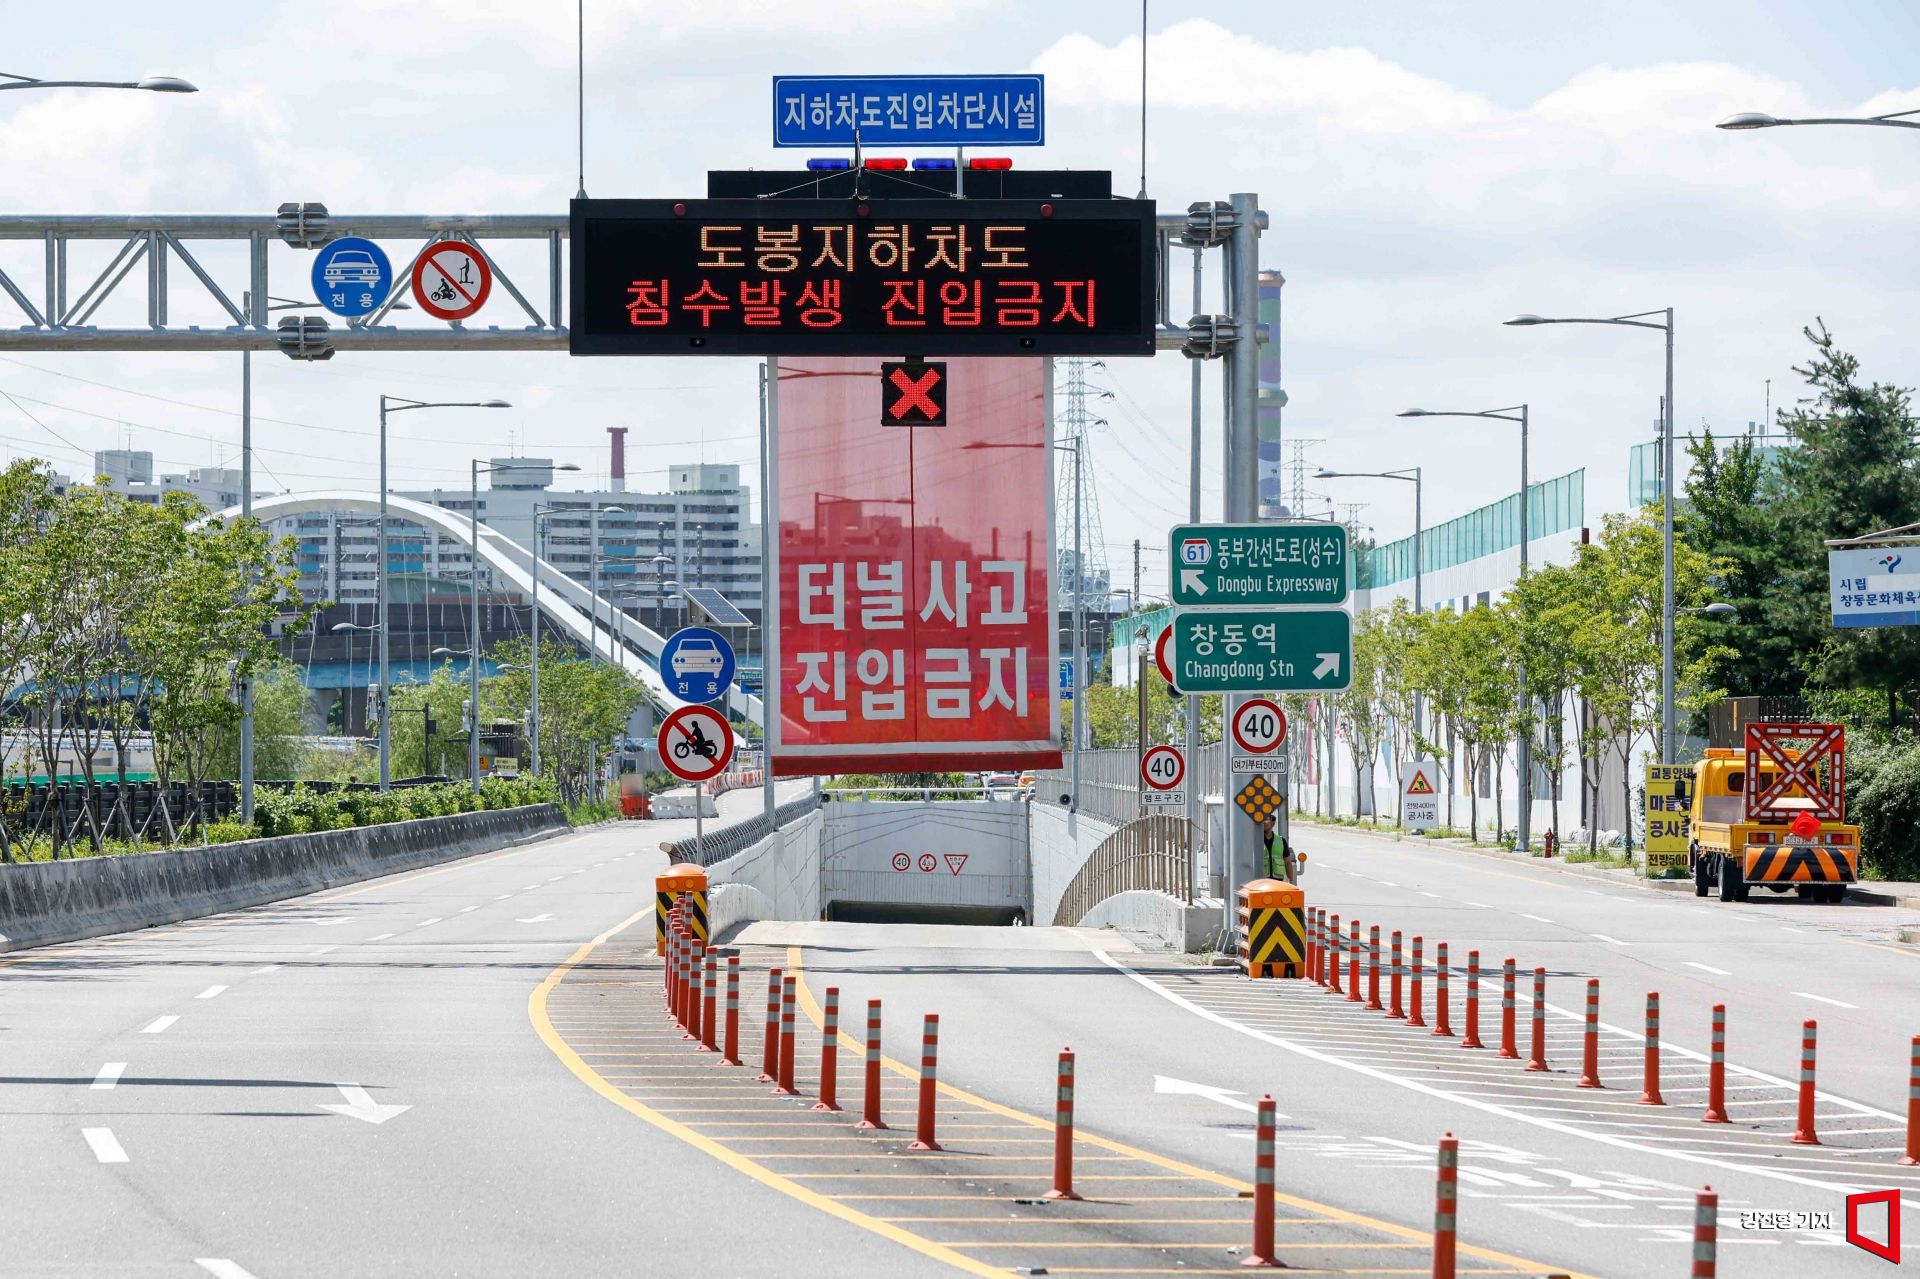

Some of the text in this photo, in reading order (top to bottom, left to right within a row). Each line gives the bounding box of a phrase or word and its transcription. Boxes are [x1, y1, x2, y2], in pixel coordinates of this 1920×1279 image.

[784, 92, 1036, 131] 지하차도진입차단시설
[697, 223, 1029, 273] 도봉지하차도
[626, 278, 1095, 328] 침수발생 진입금지
[1186, 545, 1205, 561] 61
[1217, 537, 1341, 570] 동부간선도로(성수)
[1217, 574, 1339, 596] Dongbu Expressway
[1189, 622, 1277, 656] 창동역
[1185, 659, 1294, 682] Changdong Stn
[1244, 713, 1275, 739] 40
[1151, 757, 1175, 777] 40
[1233, 759, 1284, 771] 여기부터500m
[1408, 811, 1434, 820] 공사중
[896, 857, 907, 867] 40
